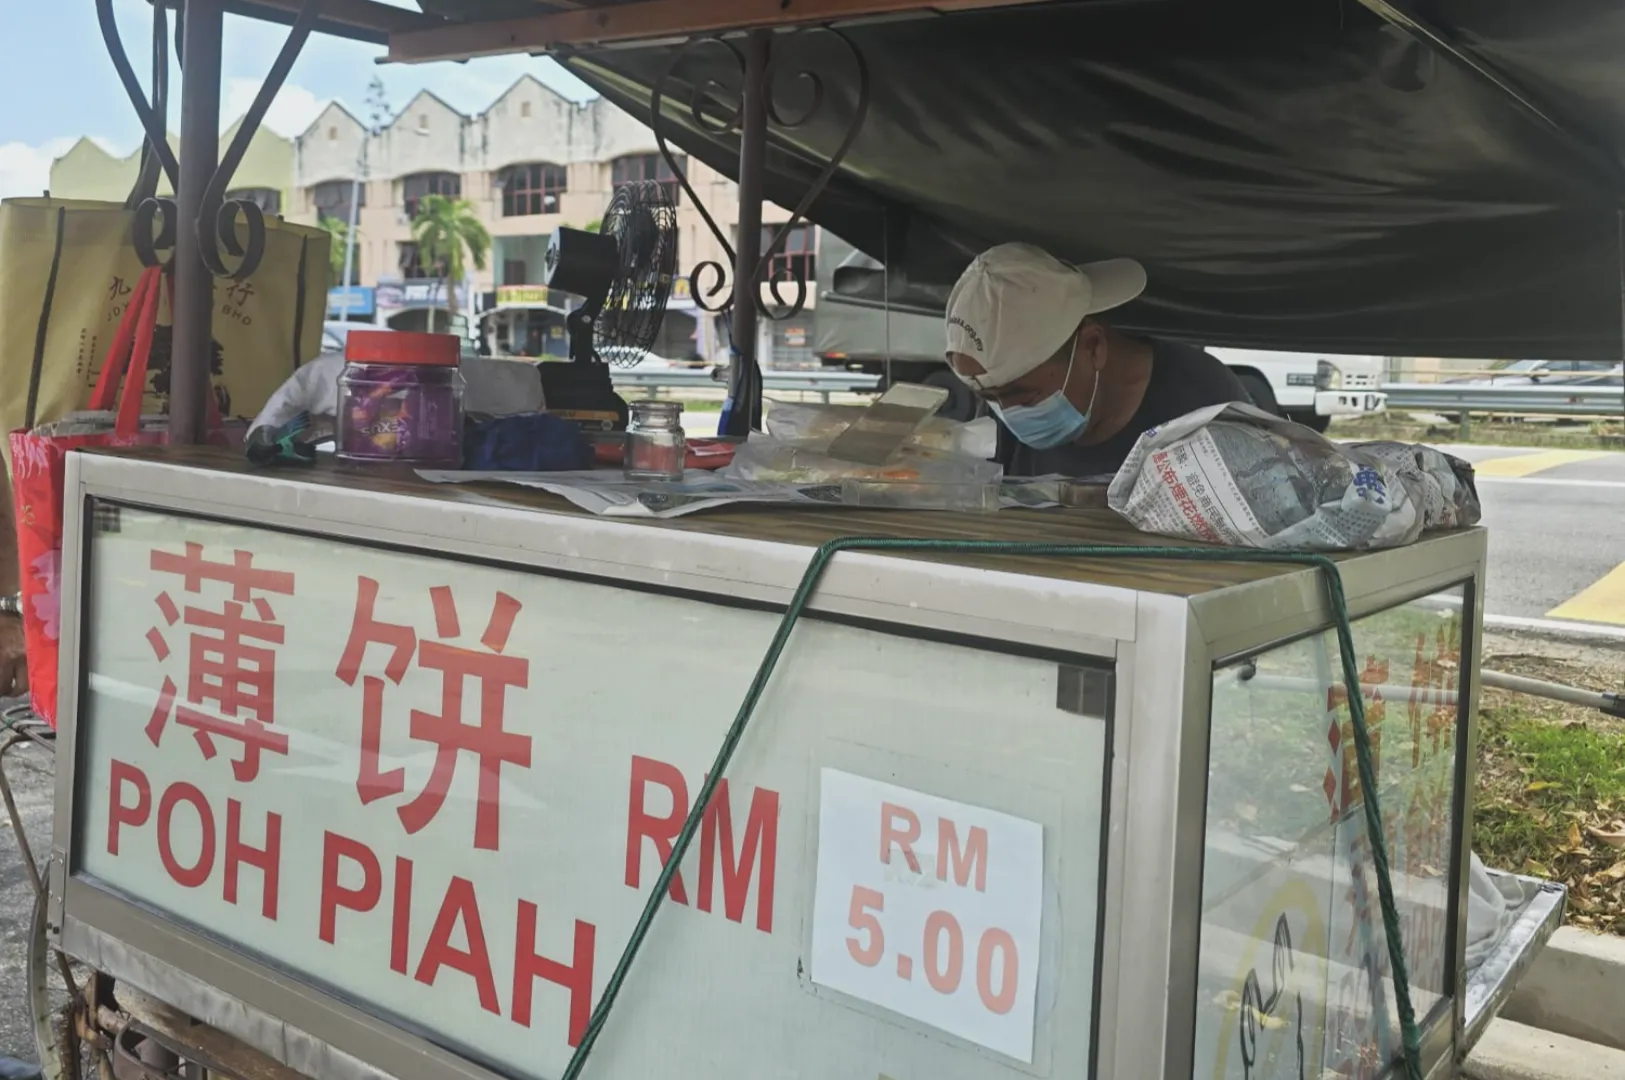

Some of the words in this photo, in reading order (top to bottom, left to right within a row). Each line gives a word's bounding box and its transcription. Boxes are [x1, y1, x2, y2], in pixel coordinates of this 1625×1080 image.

[144, 540, 533, 851] 薄饼
[106, 758, 283, 922] POH
[318, 829, 597, 1049] PIAH
[624, 754, 780, 934] RM
[878, 800, 989, 893] RM
[844, 883, 1020, 1015] 5.00
